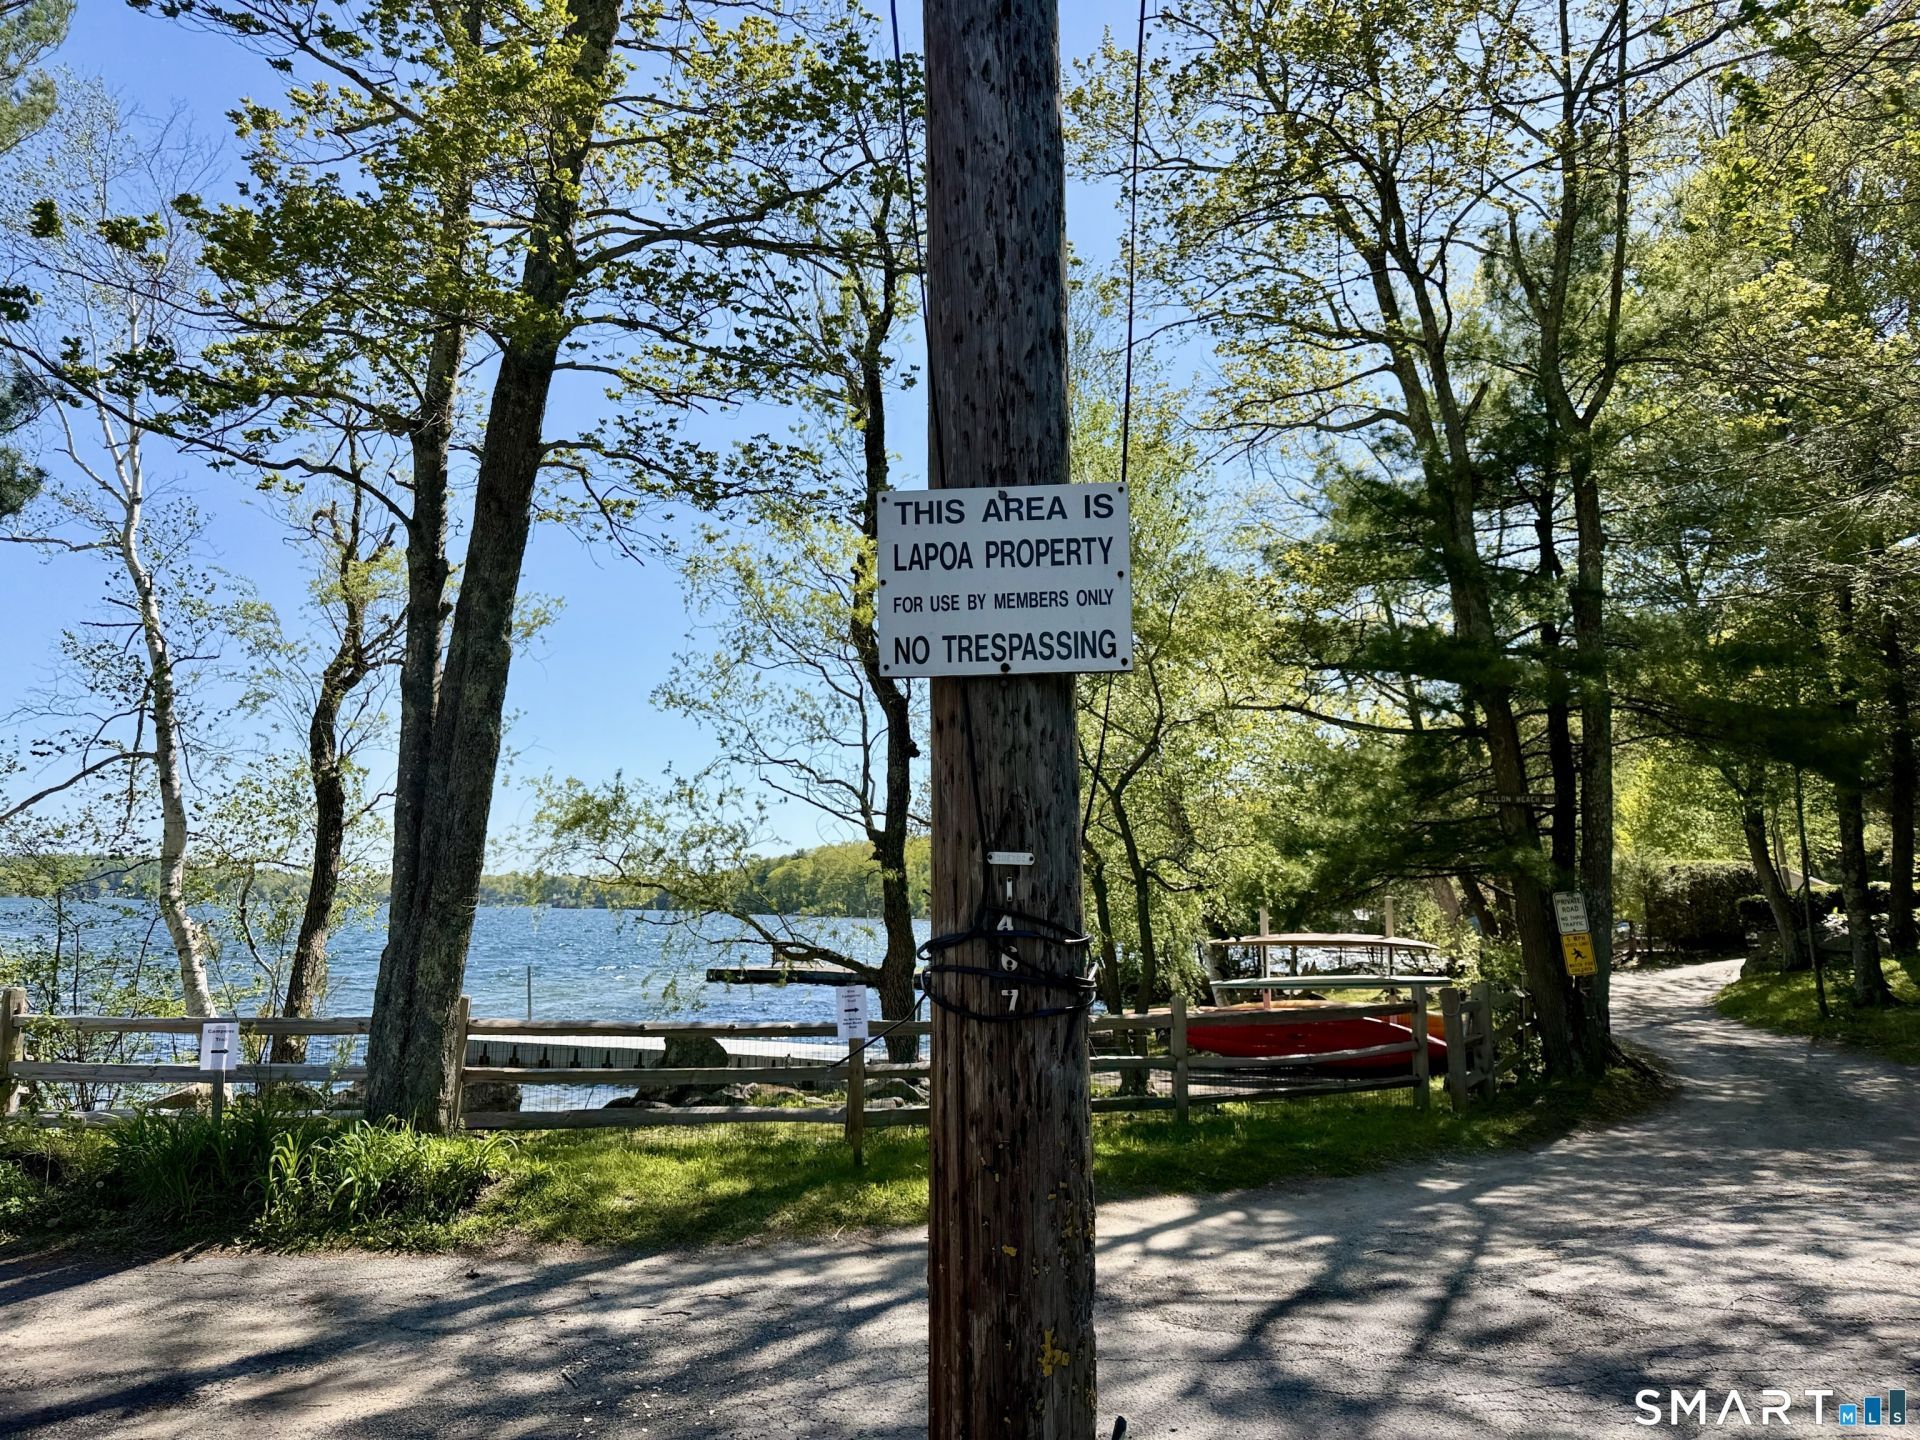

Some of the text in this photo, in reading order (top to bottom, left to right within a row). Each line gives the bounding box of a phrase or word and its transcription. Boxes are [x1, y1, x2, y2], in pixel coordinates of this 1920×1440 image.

[894, 493, 1114, 525] THIS AREA IS
[894, 536, 1114, 571] LAPOA PROPERTY
[893, 588, 1114, 613] FOR USE BY MEMBERS ONLY
[894, 629, 1117, 665] NO TRESPASSING
[1484, 795, 1511, 803] DILLON
[1556, 896, 1582, 905] PRIVATE
[1561, 905, 1580, 913] ROAD
[1562, 920, 1584, 928] TRAFFIC
